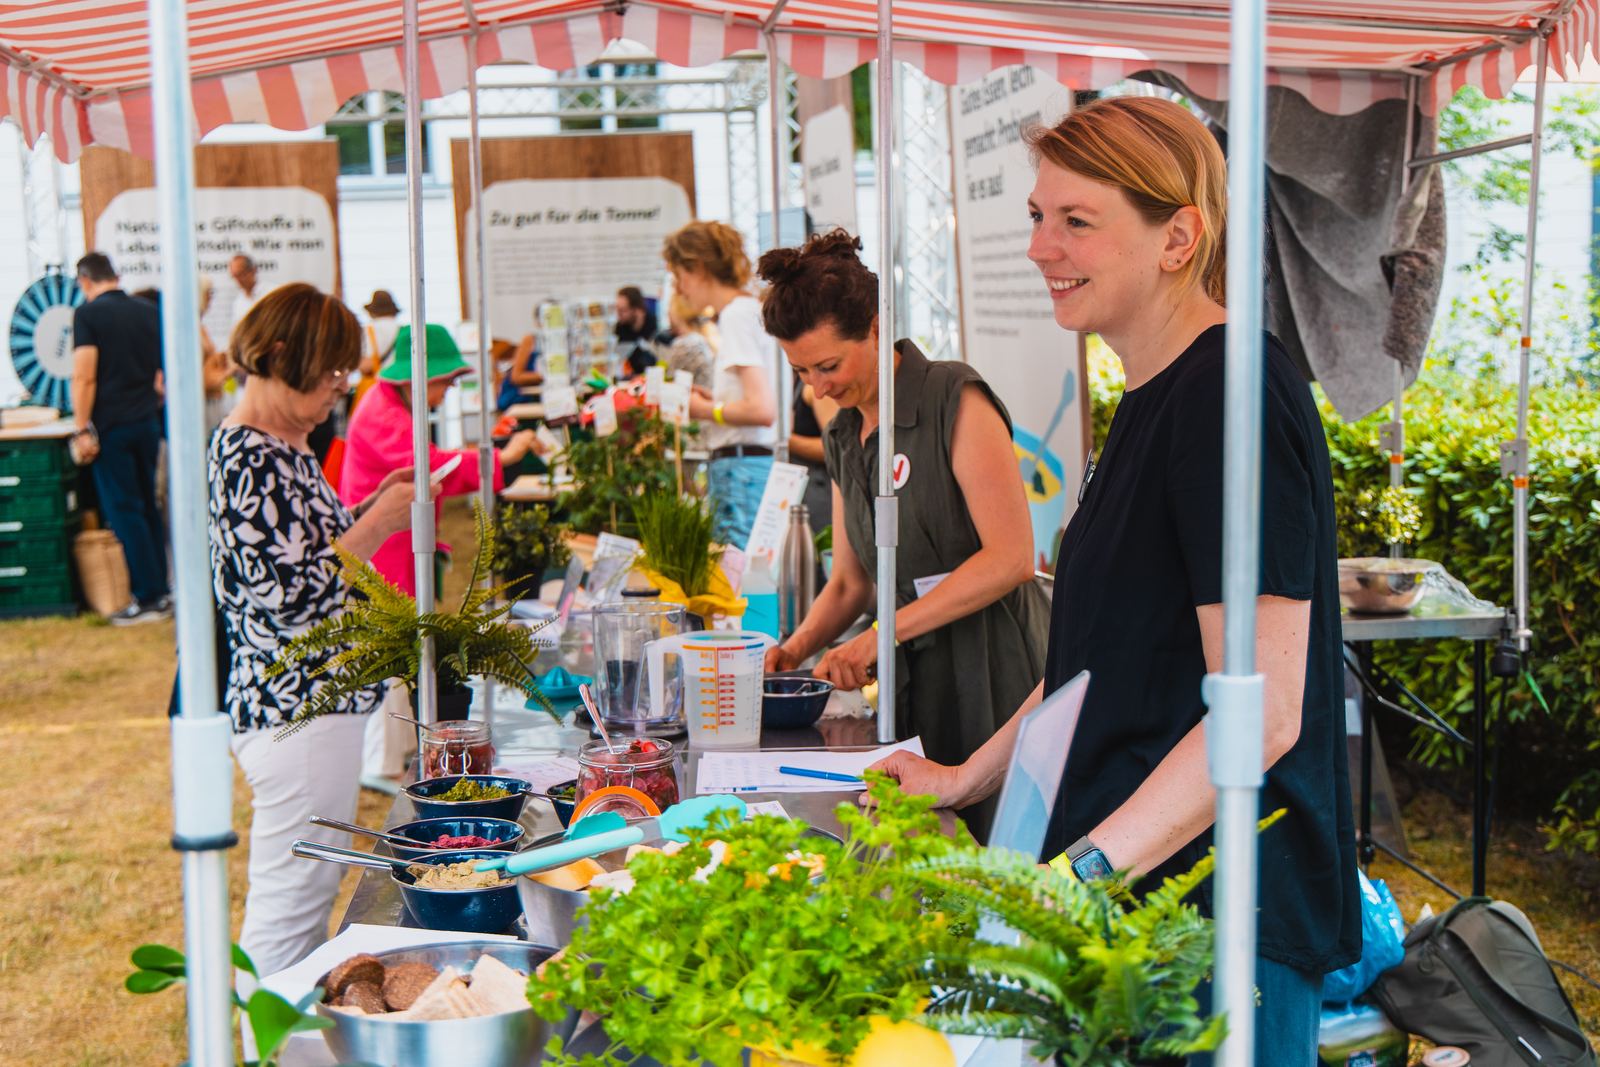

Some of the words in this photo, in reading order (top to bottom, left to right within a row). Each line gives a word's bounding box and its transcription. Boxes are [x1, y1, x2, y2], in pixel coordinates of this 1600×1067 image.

[297, 215, 314, 229] in
[491, 210, 511, 226] Zu
[515, 212, 542, 229] gut
[546, 207, 571, 225] für
[576, 206, 600, 223] die
[251, 236, 283, 250] Wie
[287, 238, 324, 250] man
